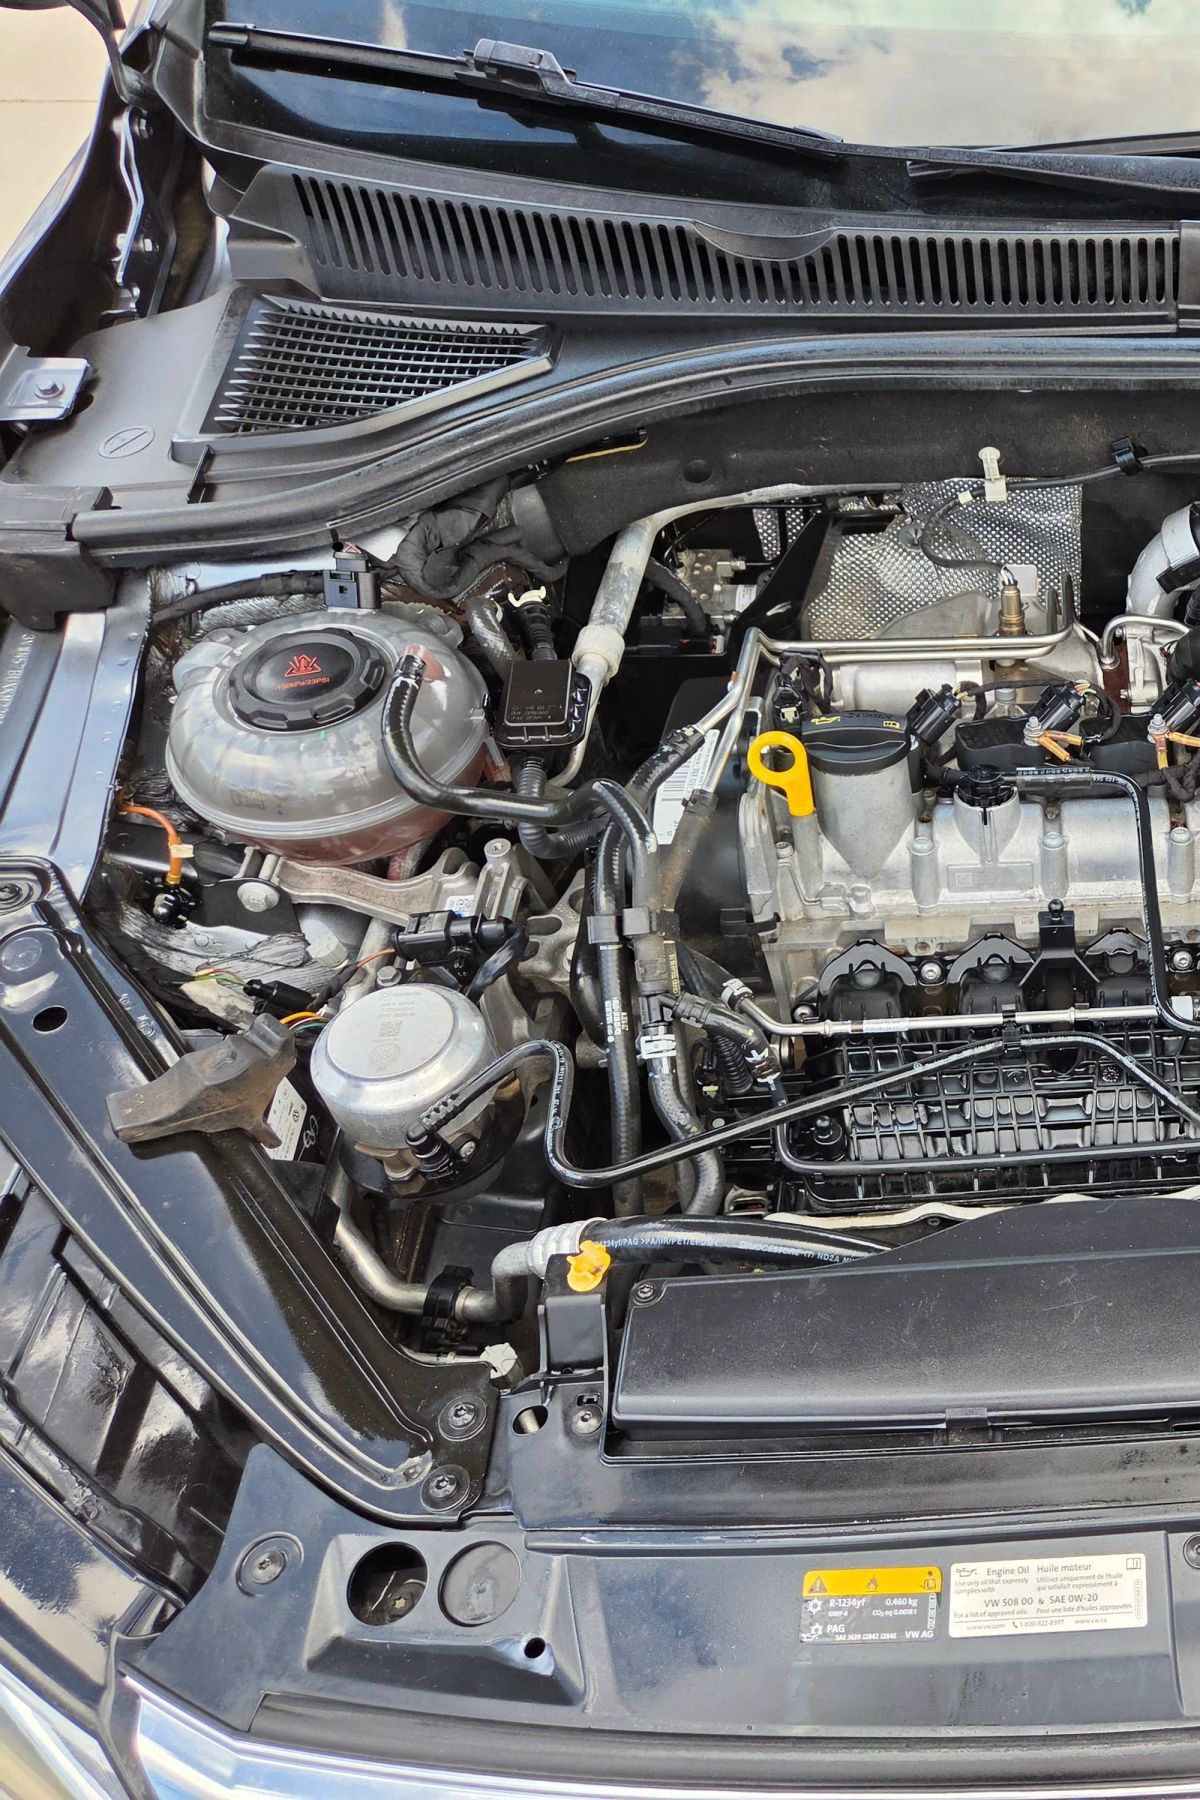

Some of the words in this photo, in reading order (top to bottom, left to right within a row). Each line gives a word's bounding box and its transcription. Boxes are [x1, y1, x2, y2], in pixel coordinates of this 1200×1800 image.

[986, 1565, 1015, 1578] Engine
[1017, 1564, 1029, 1574] Oil
[1037, 1563, 1058, 1573] Huile
[1060, 1562, 1092, 1572] moteur
[1096, 1572, 1104, 1580] de
[966, 1579, 980, 1587] only
[988, 1578, 1001, 1586] that
[981, 1586, 995, 1594] with
[828, 1596, 866, 1609] R-1234yf
[907, 1596, 918, 1607] kg
[983, 1598, 1000, 1608] VW
[1001, 1597, 1019, 1607] 508
[1020, 1596, 1033, 1606] 00
[1049, 1594, 1065, 1604] SAE
[1068, 1593, 1098, 1603] 0W-20
[953, 1611, 963, 1619] For
[964, 1611, 968, 1619] a
[979, 1610, 986, 1618] of
[1036, 1606, 1049, 1614] Pour
[826, 1623, 845, 1633] PAG
[904, 1630, 920, 1638] VW
[920, 1630, 934, 1638] AG
